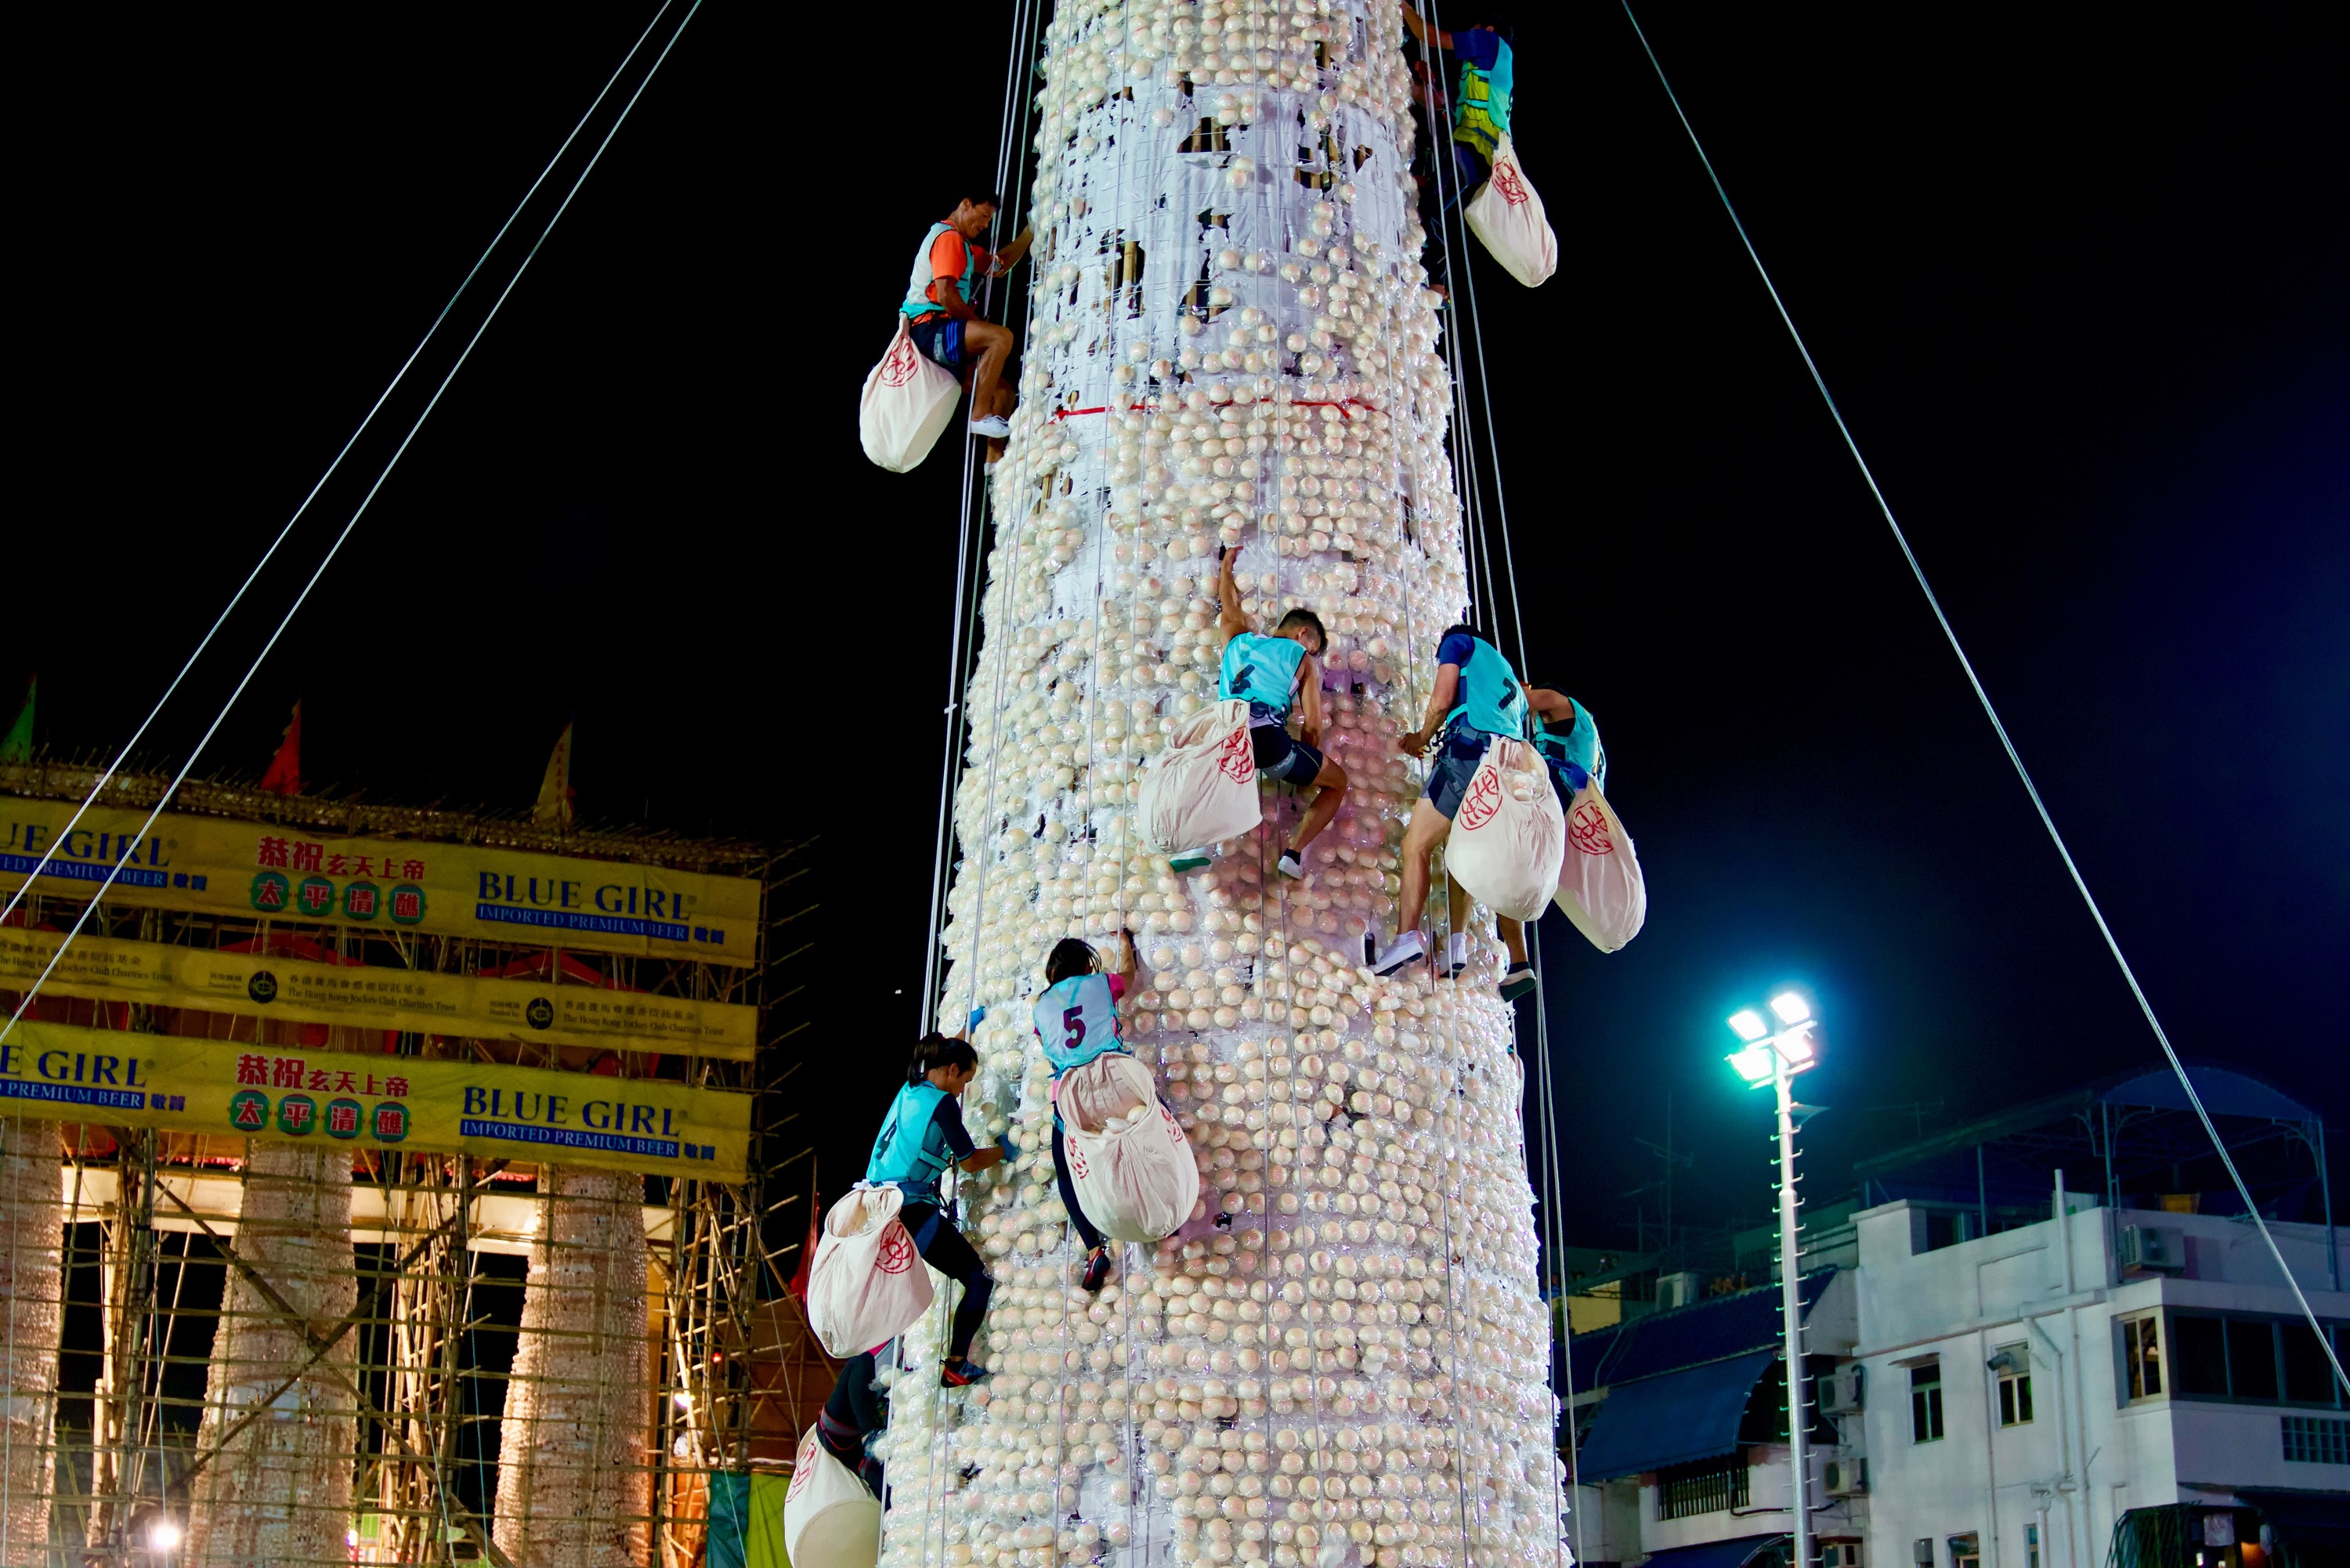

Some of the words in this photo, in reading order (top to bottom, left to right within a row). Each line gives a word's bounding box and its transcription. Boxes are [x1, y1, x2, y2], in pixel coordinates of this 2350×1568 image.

[62, 829, 170, 867] GIRL
[258, 836, 425, 880] 恭祝玄天上帝
[121, 869, 164, 887] BEER
[478, 871, 581, 909] BLUE
[595, 884, 690, 921] GIRL
[256, 879, 421, 918] 太平清醮
[479, 905, 565, 927] IMPORTED
[569, 914, 645, 934] PREMIUM
[649, 921, 685, 940] BEER
[288, 988, 302, 997] The
[305, 989, 326, 1001] Hong
[328, 992, 349, 1003] Kong
[350, 994, 377, 1005] Jockey
[378, 995, 397, 1006] Club
[399, 997, 434, 1009] Charities
[436, 1001, 457, 1011] Trust
[1063, 1005, 1086, 1049] 5
[38, 1050, 146, 1088] GIRL
[237, 1053, 409, 1097] 恭祝玄天上帝
[7, 1081, 92, 1103] PREMIUM
[98, 1091, 141, 1108] BEER
[462, 1086, 569, 1125] BLUE
[582, 1100, 680, 1137] GIRL
[237, 1098, 403, 1136] 太平清醮
[463, 1121, 550, 1142] IMPORTED
[554, 1130, 631, 1151] PREMIUM
[636, 1139, 676, 1157] BEER
